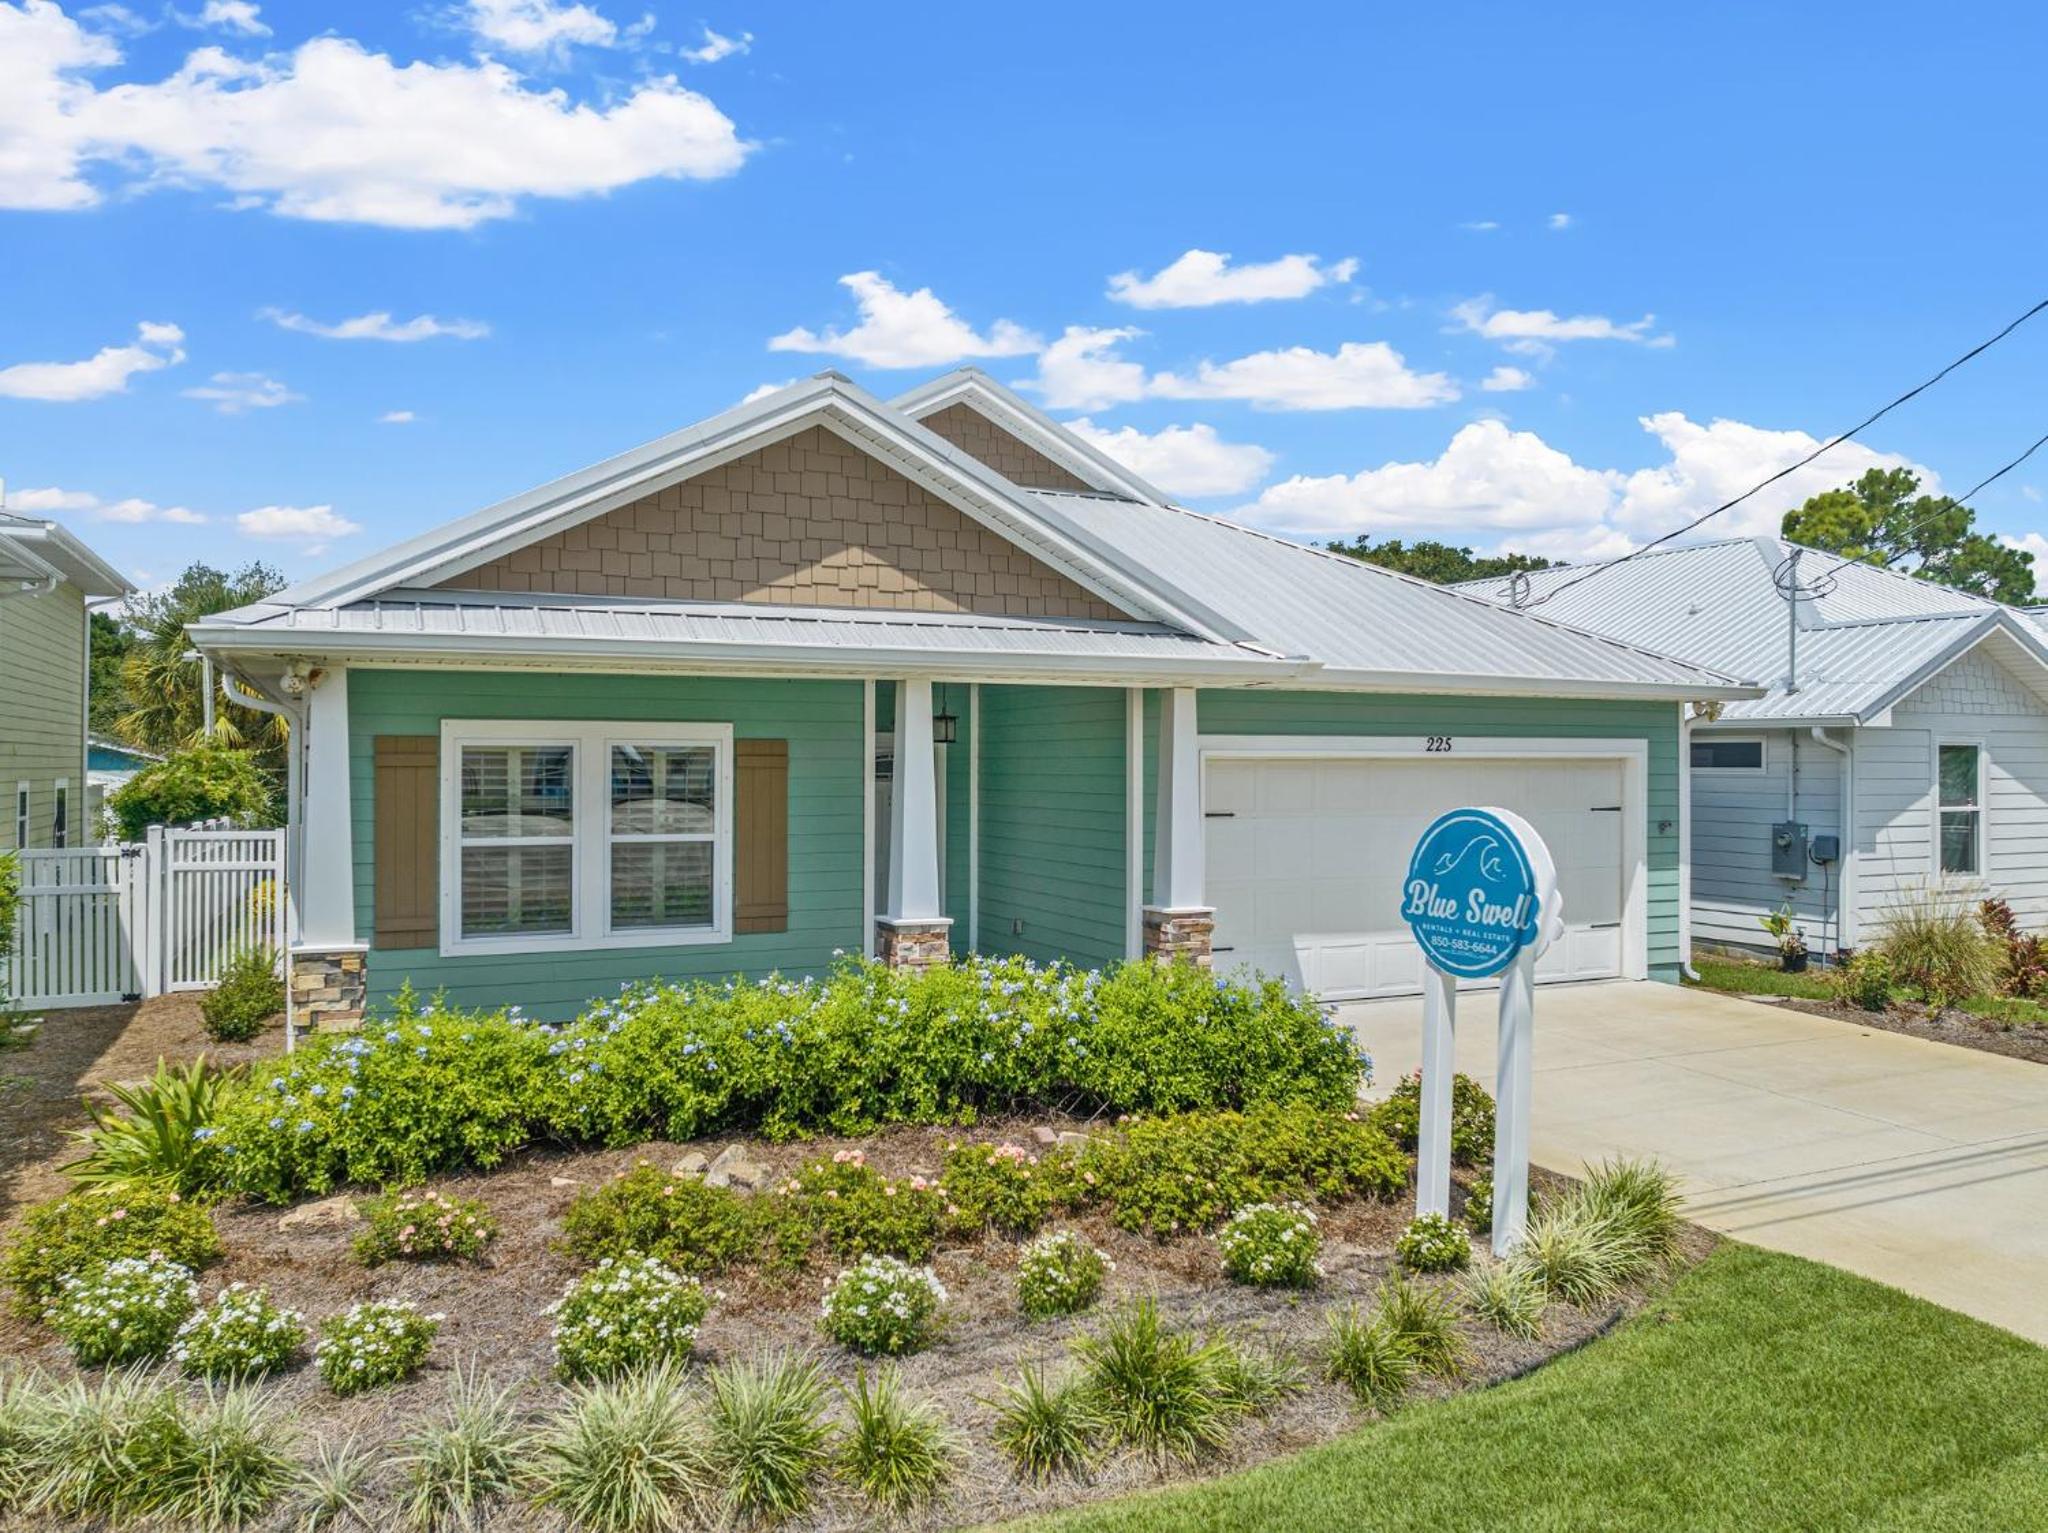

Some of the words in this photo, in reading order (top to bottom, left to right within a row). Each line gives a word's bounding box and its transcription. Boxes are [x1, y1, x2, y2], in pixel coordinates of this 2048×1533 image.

[1426, 736, 1452, 752] 225
[1406, 879, 1459, 920] Blue
[1466, 888, 1531, 930] Swell
[1422, 923, 1453, 933] RENTALS
[1462, 929, 1480, 937] REAL
[1483, 932, 1510, 942] ESTATE
[1431, 935, 1498, 954] 850-583-6644
